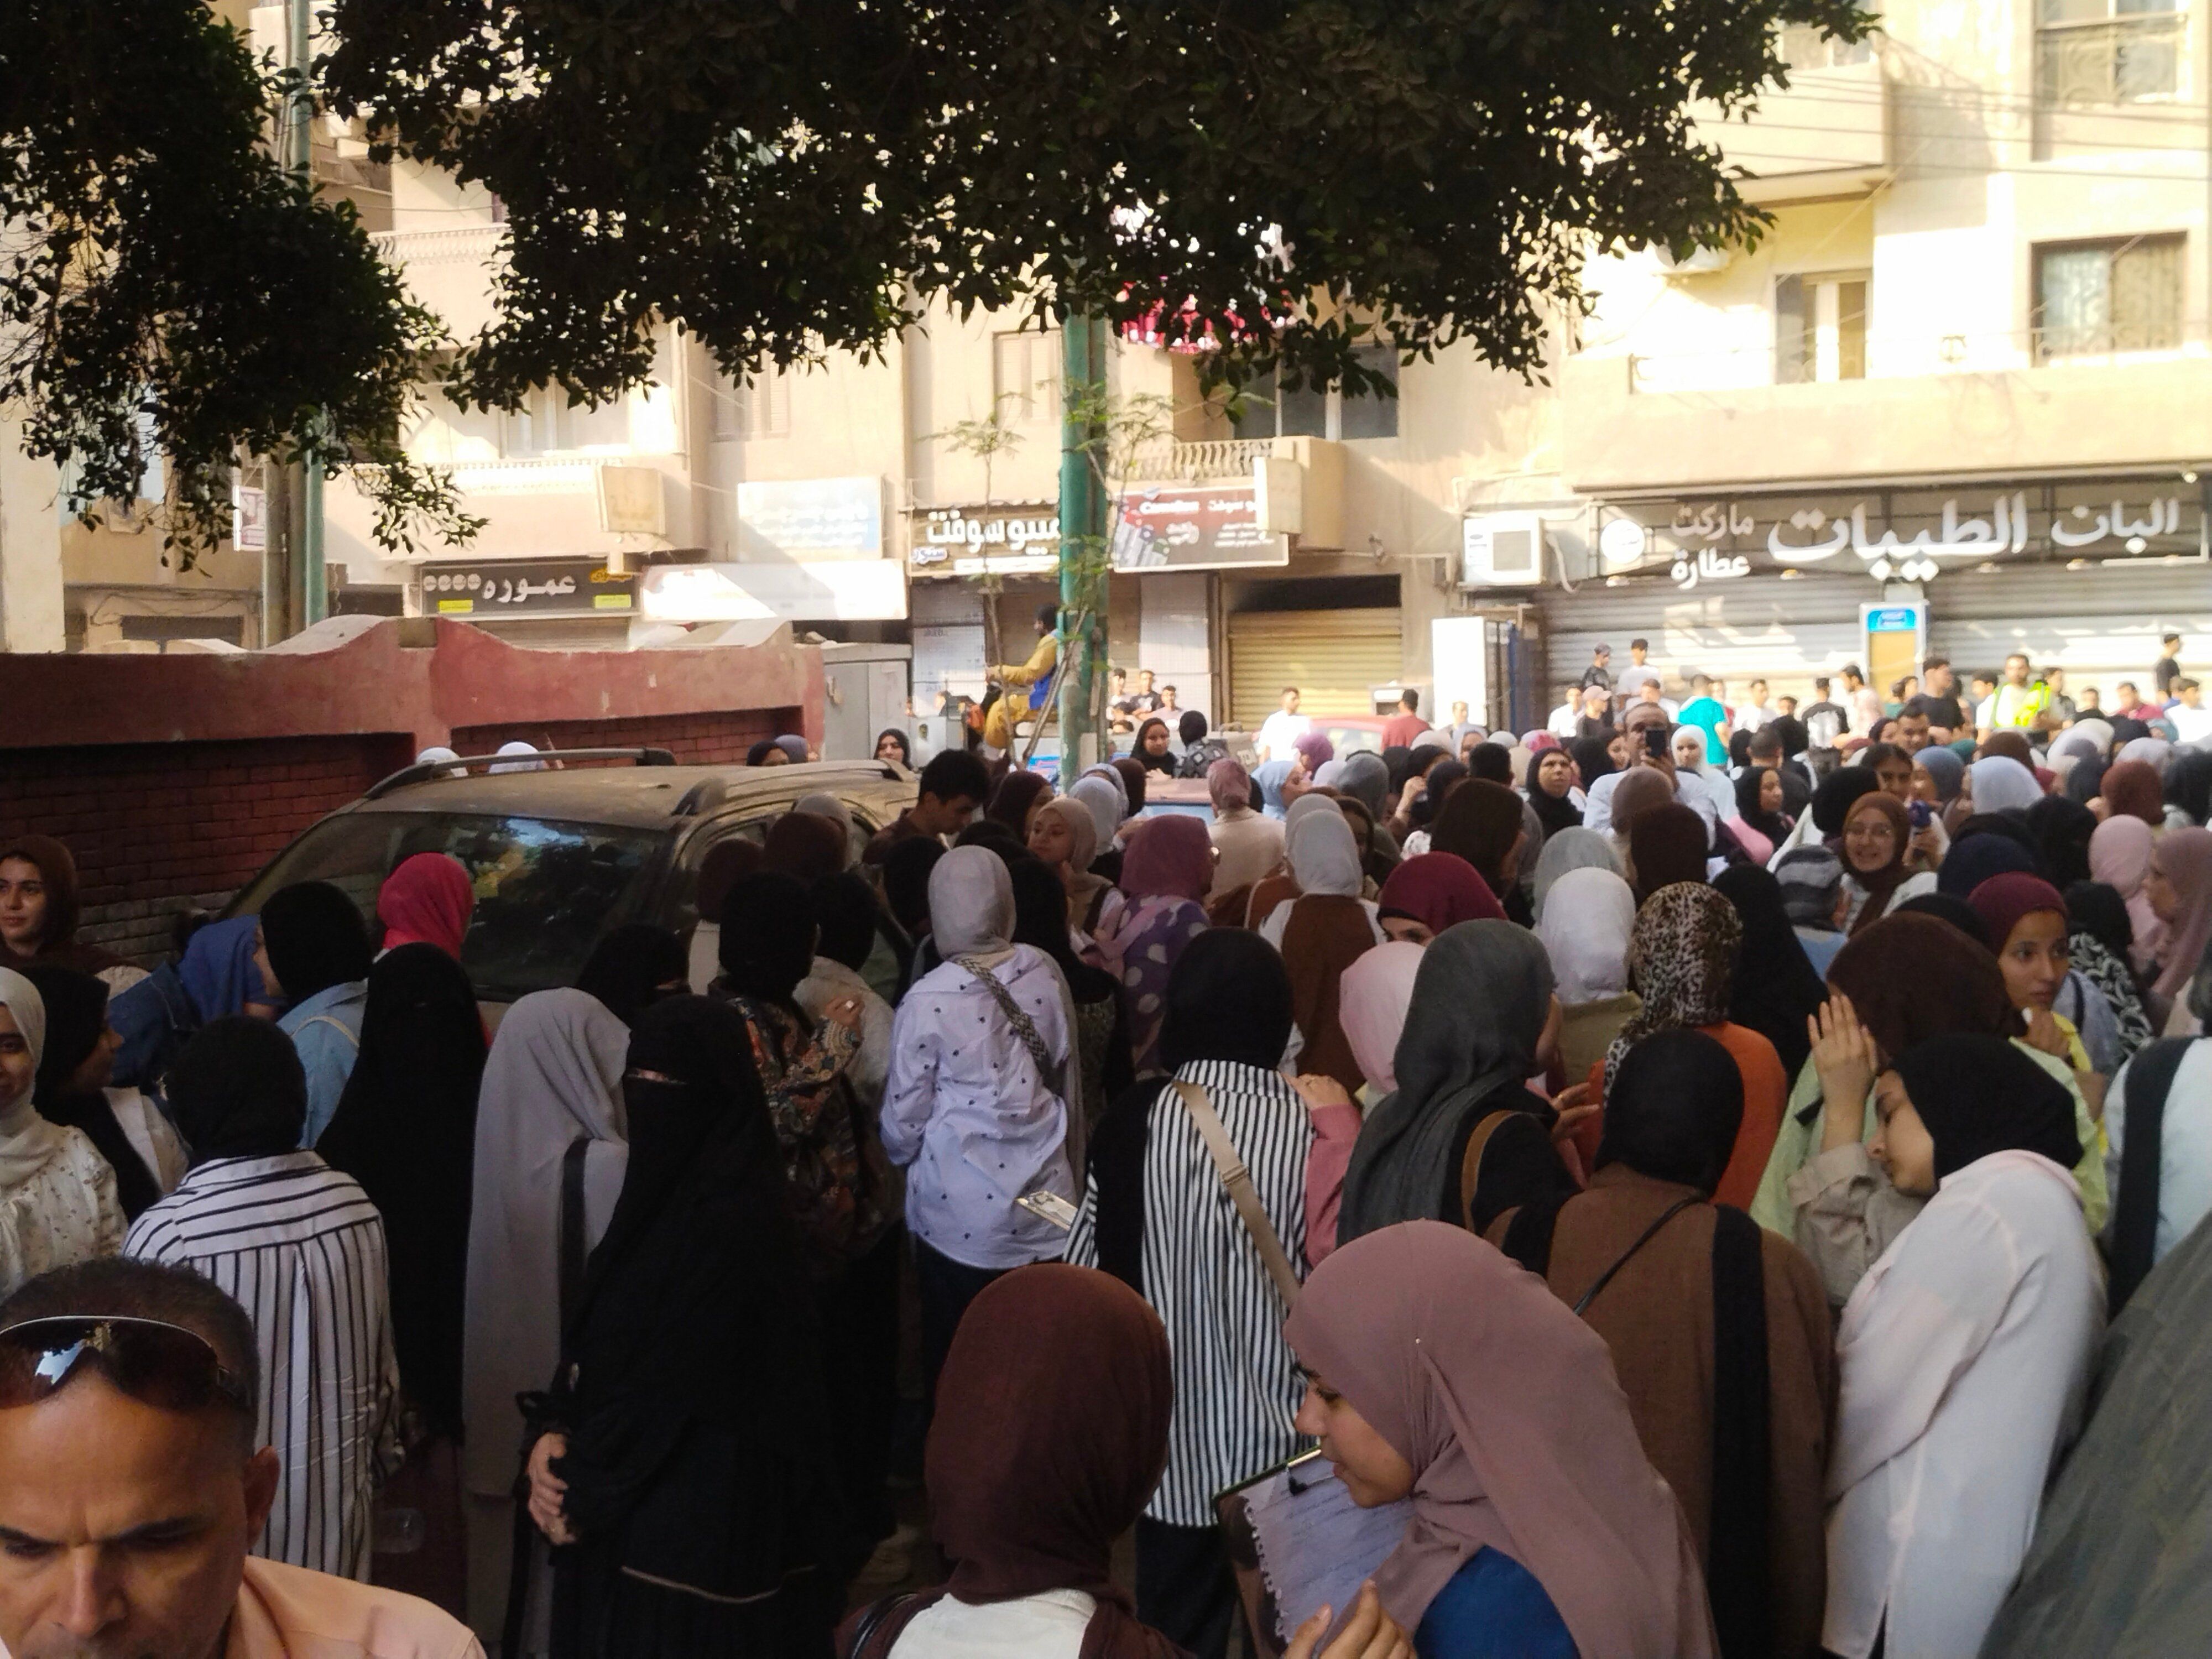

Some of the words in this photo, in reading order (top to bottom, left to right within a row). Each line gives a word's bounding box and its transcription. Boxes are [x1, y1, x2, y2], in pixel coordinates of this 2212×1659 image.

[1671, 503, 1755, 541] ماركت
[1767, 491, 2028, 581] الطيبات
[2051, 498, 2179, 554] البان
[1671, 546, 1751, 590] عطارة
